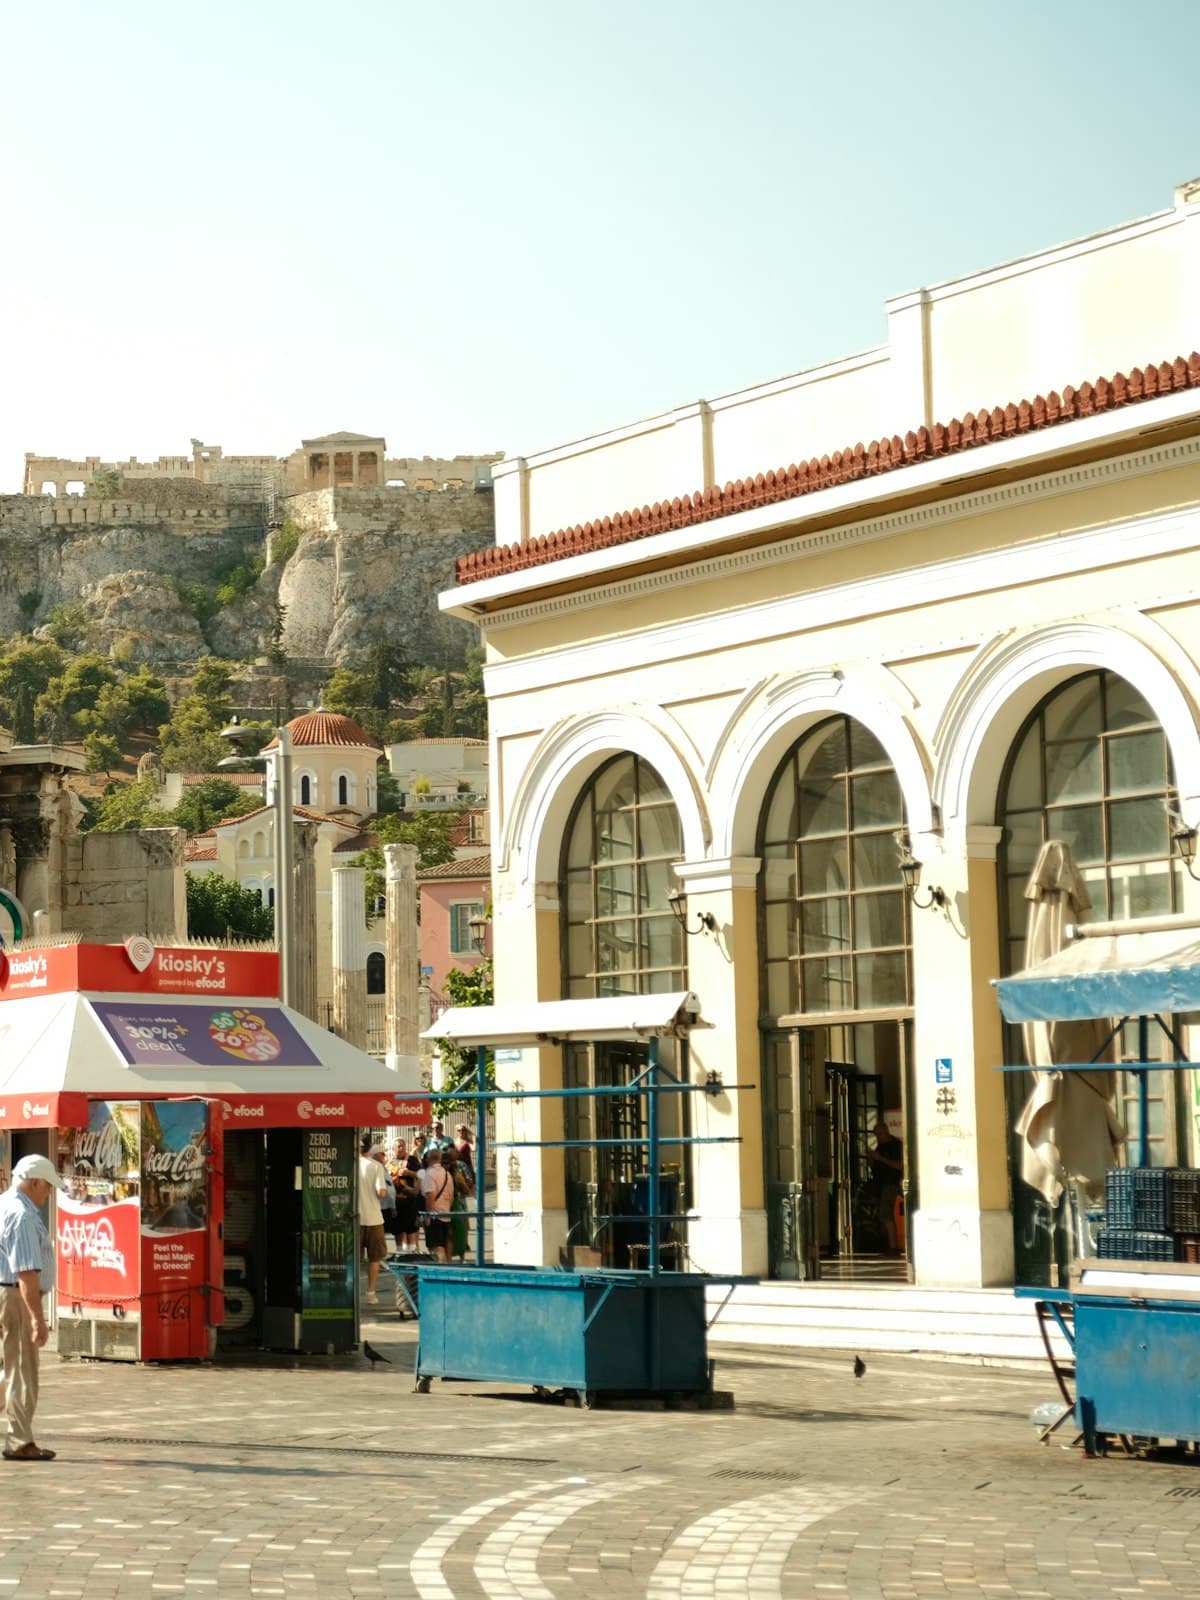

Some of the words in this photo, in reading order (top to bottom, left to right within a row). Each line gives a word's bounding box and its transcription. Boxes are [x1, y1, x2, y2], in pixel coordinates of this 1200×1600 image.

[9, 955, 47, 975] kiosky's
[158, 953, 225, 975] kiosky's
[195, 976, 225, 988] efood
[136, 1040, 186, 1052] deals
[234, 1105, 264, 1116] efood
[315, 1104, 345, 1115] efood
[395, 1104, 424, 1115] efood
[309, 1133, 331, 1146] ZERO
[309, 1148, 338, 1160] SUGAR
[309, 1161, 332, 1174] 100%
[309, 1176, 348, 1188] MONSTER
[153, 1244, 170, 1252] Feel
[171, 1244, 184, 1252] the
[172, 1254, 195, 1262] Magic
